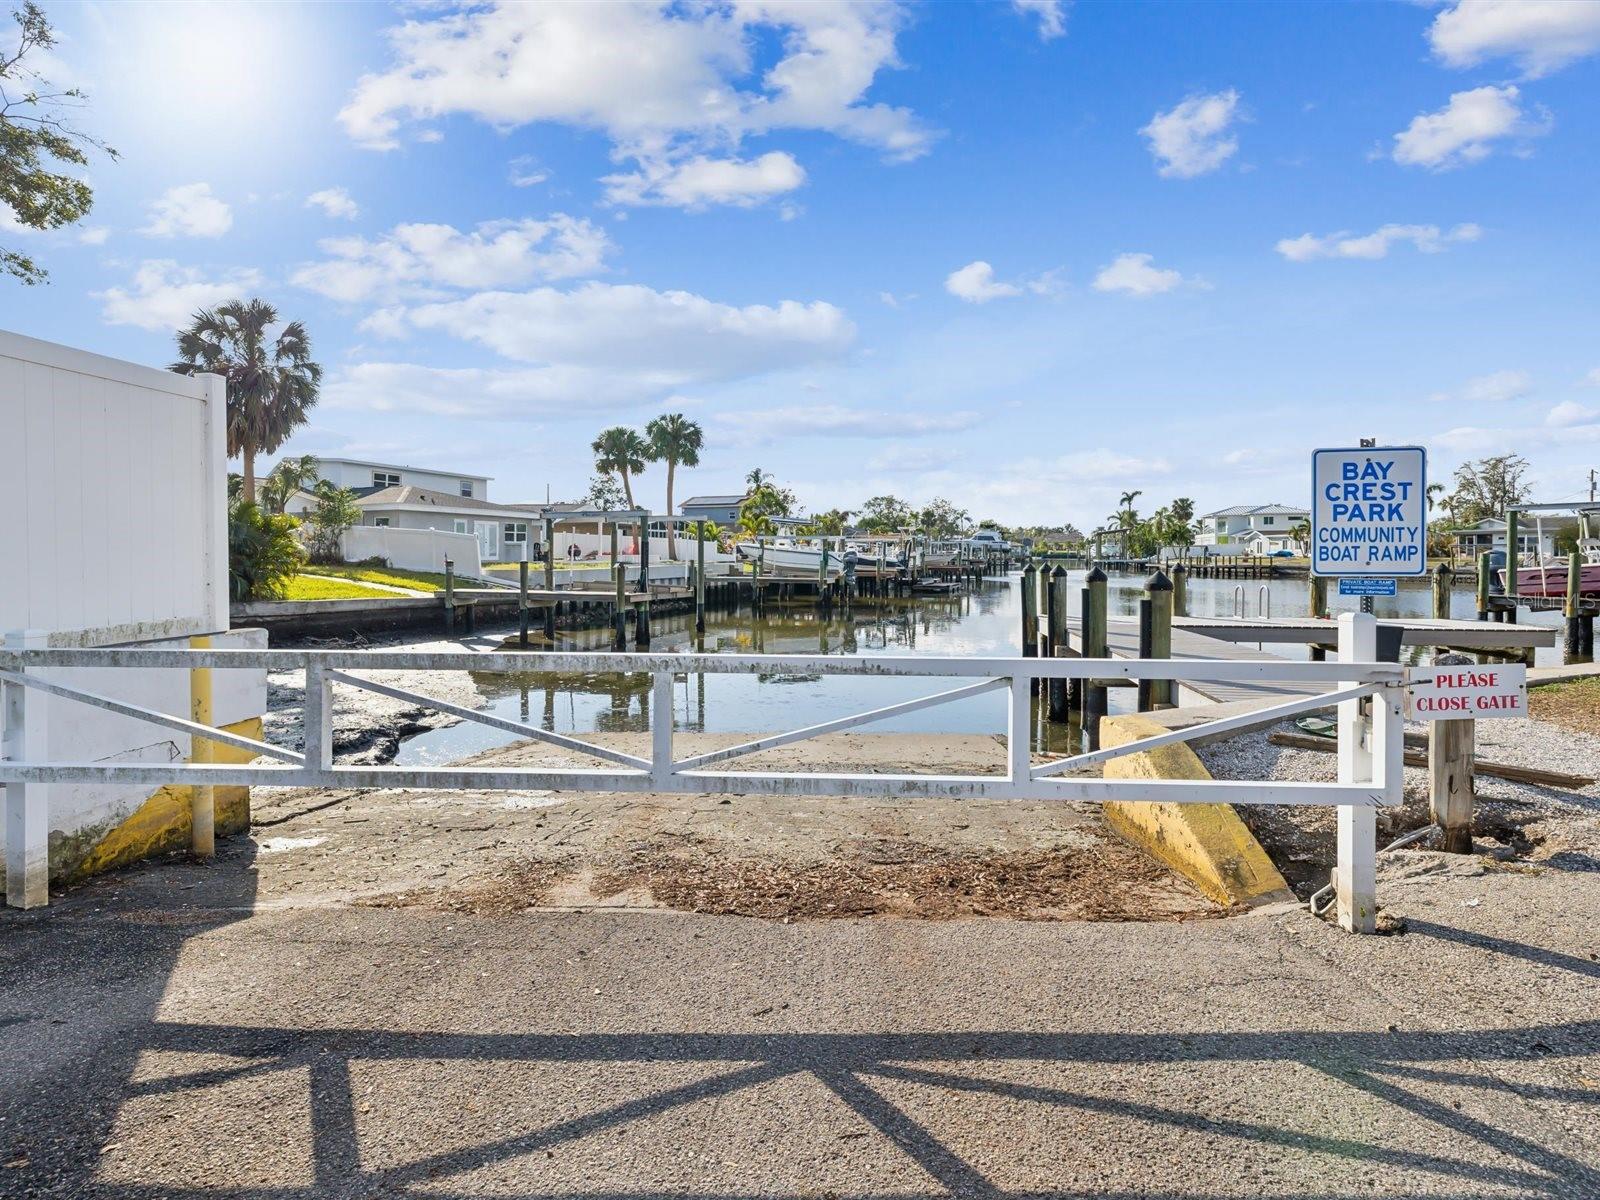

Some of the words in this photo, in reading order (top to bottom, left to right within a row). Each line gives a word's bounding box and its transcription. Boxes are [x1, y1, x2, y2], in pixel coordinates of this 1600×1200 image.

[1342, 461, 1394, 480] BAY
[1325, 482, 1412, 501] CREST
[1332, 503, 1404, 522] PARK
[1319, 526, 1418, 543] COMMUNITY
[1319, 545, 1360, 561] BOAT
[1368, 545, 1418, 561] RAMP
[1436, 672, 1499, 688] PLEASE
[1416, 696, 1471, 711] CLOSE
[1476, 695, 1521, 710] GATE
